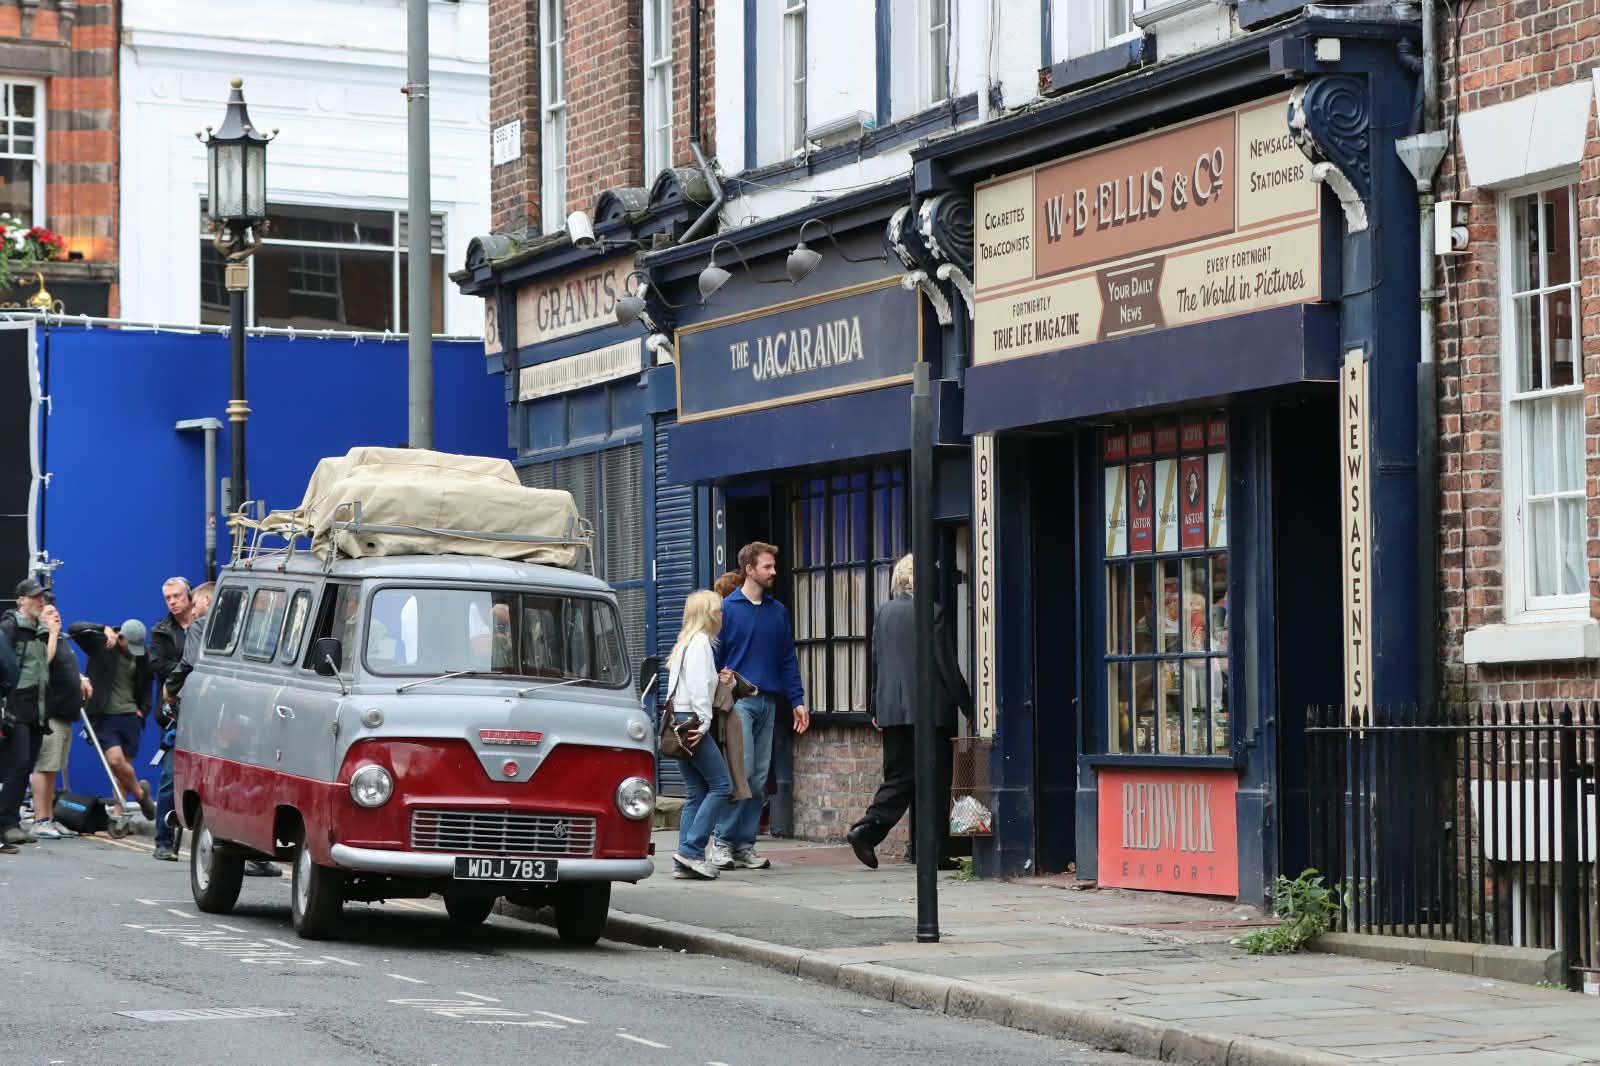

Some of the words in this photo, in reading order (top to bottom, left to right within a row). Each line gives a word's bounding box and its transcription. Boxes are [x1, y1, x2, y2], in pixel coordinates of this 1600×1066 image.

[1250, 133, 1297, 160] NEWSAGE
[1172, 171, 1189, 212] &
[1250, 163, 1304, 193] STATIONERS
[984, 207, 1025, 231] CIGARETTES
[979, 235, 1030, 261] TOBACCONISTS
[1206, 254, 1230, 275] EVERY
[1231, 245, 1272, 270] FORTNIGHT
[537, 268, 616, 332] GRANTS
[1107, 281, 1130, 303] YOUR
[1131, 276, 1155, 298] DAILY
[1176, 287, 1199, 313] The
[1200, 275, 1236, 308] World
[1239, 278, 1252, 299] in
[1254, 266, 1307, 298] Pictures
[1012, 296, 1051, 319] FORTNIGHTLY
[1120, 304, 1142, 325] NEWS
[993, 328, 1013, 352] TRUE
[1015, 322, 1033, 347] LIFE
[1035, 312, 1080, 343] MAGAZINE
[730, 340, 749, 371] THE
[752, 315, 864, 381] JACARANDA
[1133, 517, 1152, 529] ASTOR
[1184, 511, 1204, 525] ASTOR
[1347, 394, 1362, 697] NEWSAGENTS
[1122, 783, 1215, 853] REDWICK
[468, 859, 505, 878] WDJ
[511, 860, 546, 879] 783
[1122, 861, 1215, 880] EXPORT
